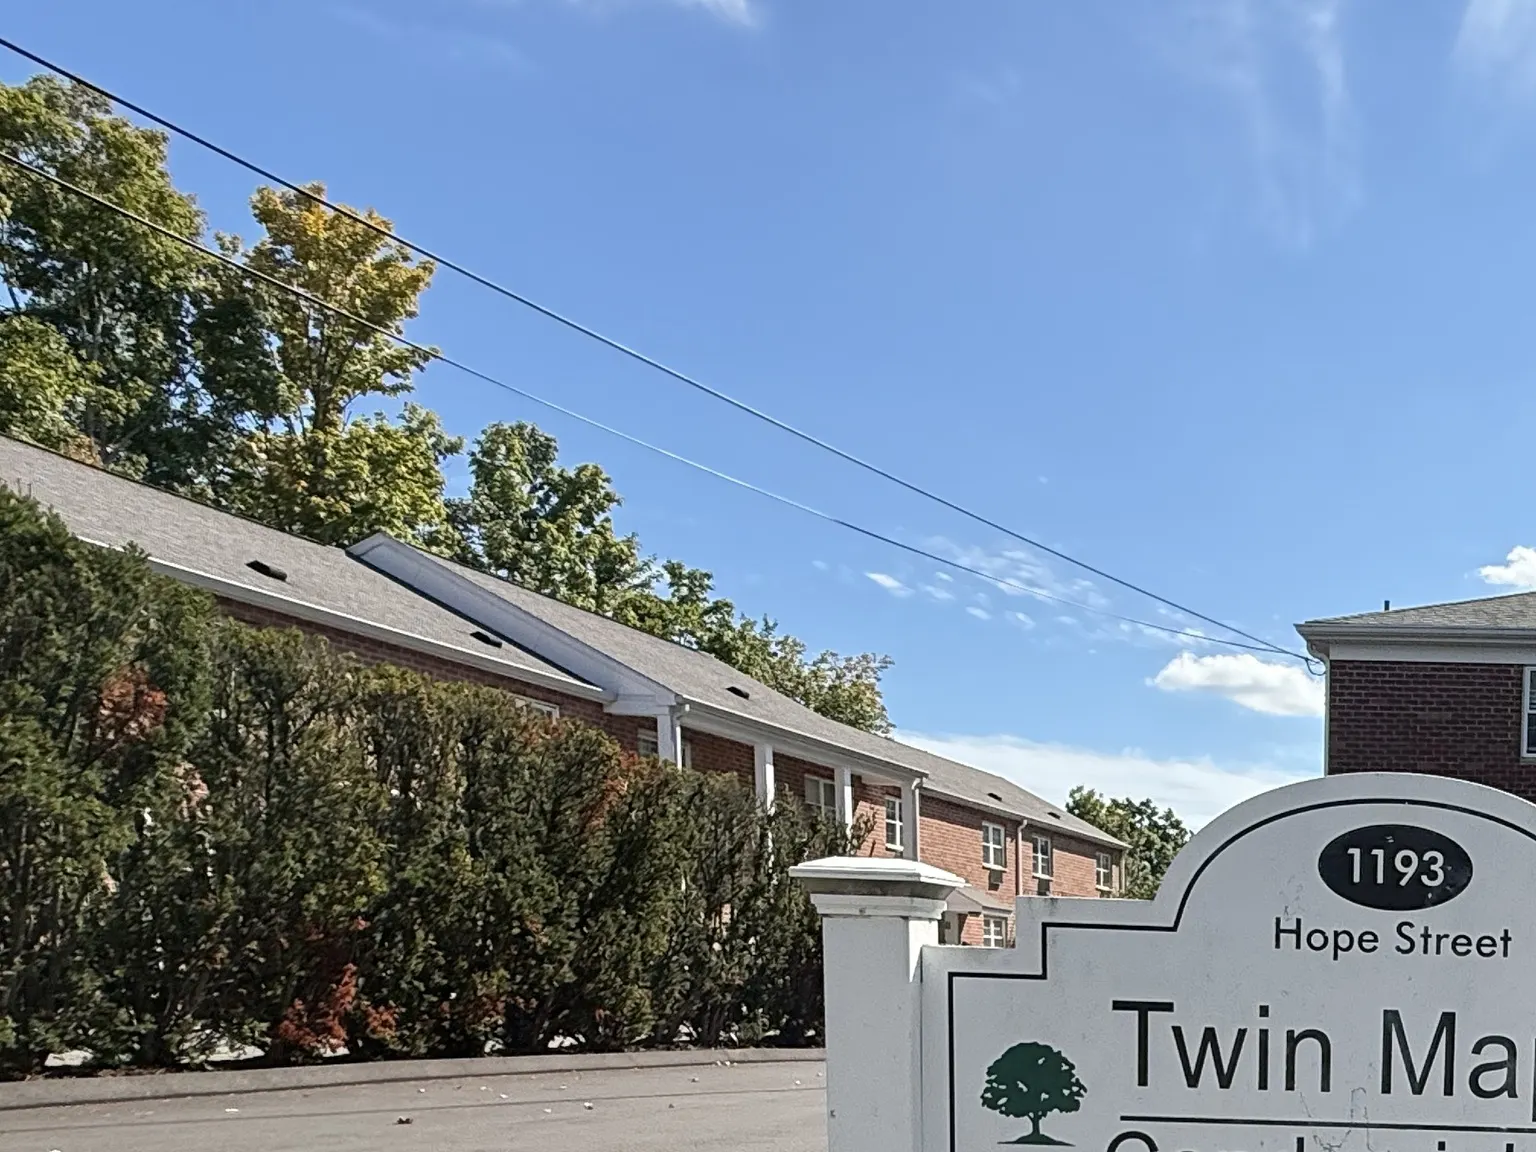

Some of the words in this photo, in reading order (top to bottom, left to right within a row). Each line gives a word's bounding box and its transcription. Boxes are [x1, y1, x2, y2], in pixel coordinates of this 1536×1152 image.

[1346, 847, 1446, 887] 1193
[1273, 915, 1380, 962] Hope
[1393, 919, 1513, 958] Street
[1110, 998, 1333, 1094] Twin
